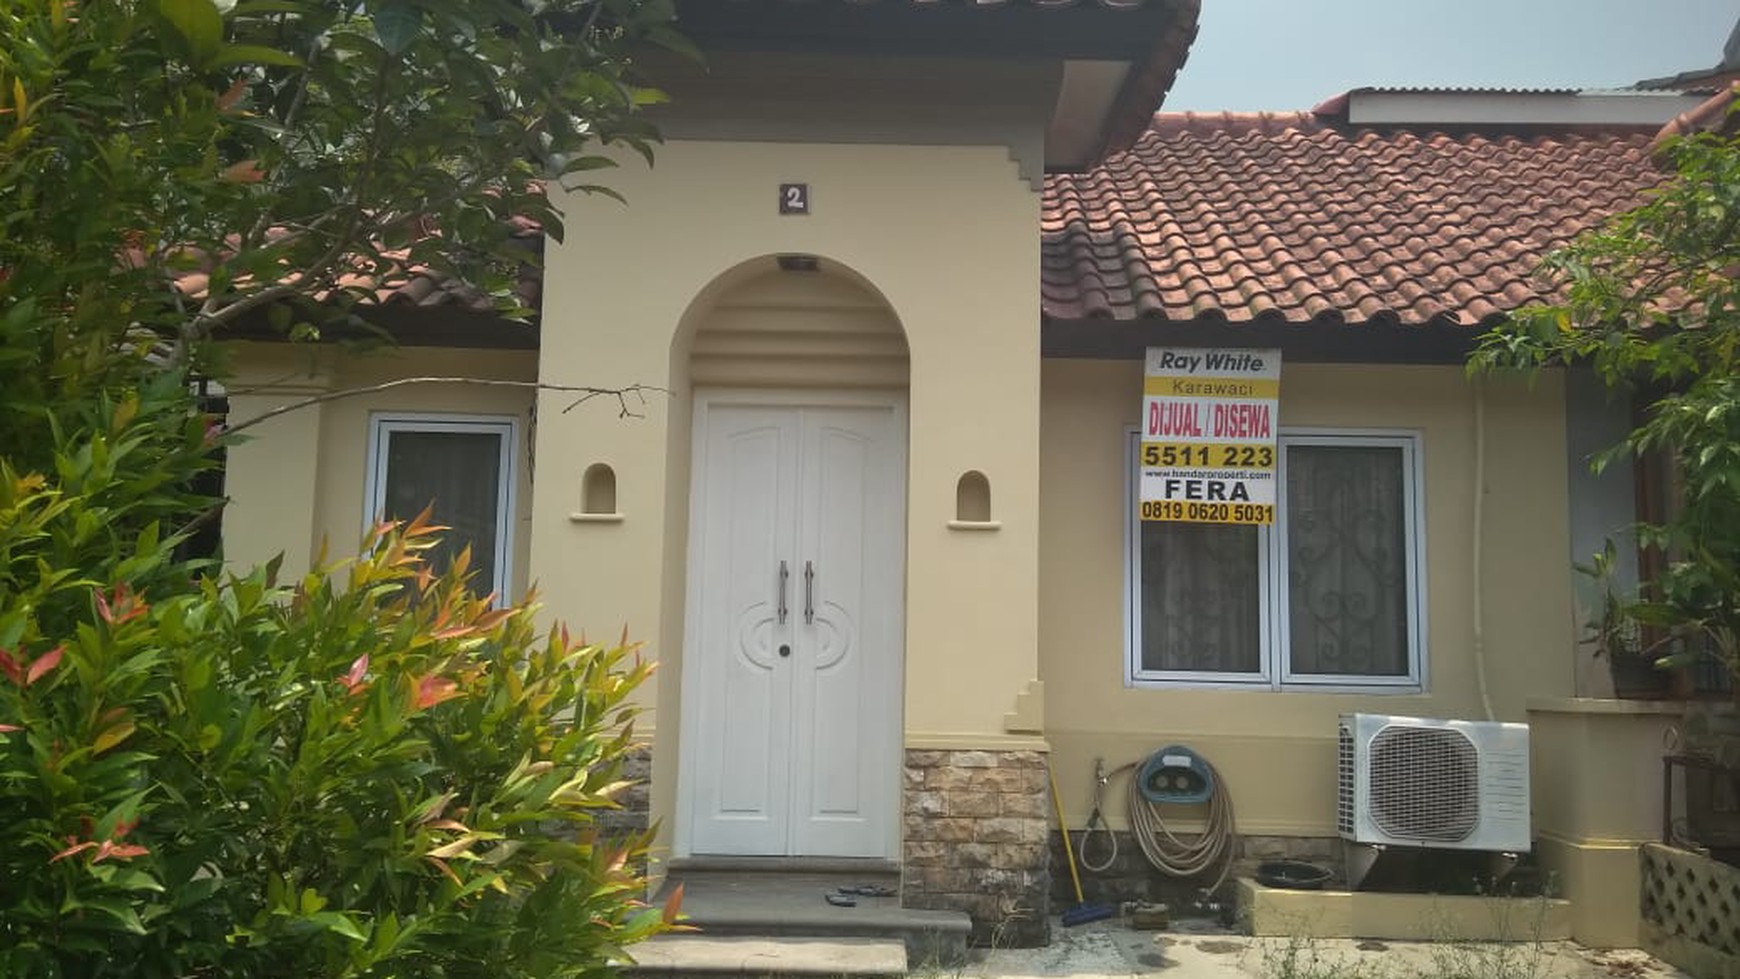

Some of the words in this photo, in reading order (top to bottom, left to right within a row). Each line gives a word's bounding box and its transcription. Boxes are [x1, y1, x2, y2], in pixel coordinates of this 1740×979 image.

[787, 186, 804, 208] 2
[1160, 352, 1201, 373] Ray
[1205, 353, 1264, 371] White
[1172, 380, 1254, 396] Karawaci
[1149, 401, 1202, 436] DIJUAL
[1214, 404, 1270, 438] DISEWA
[1145, 446, 1210, 466] 5511
[1223, 446, 1273, 467] 223
[1165, 480, 1250, 501] FERA
[1142, 501, 1183, 519] 0819
[1188, 503, 1229, 521] 0620
[1234, 505, 1273, 523] 5031
